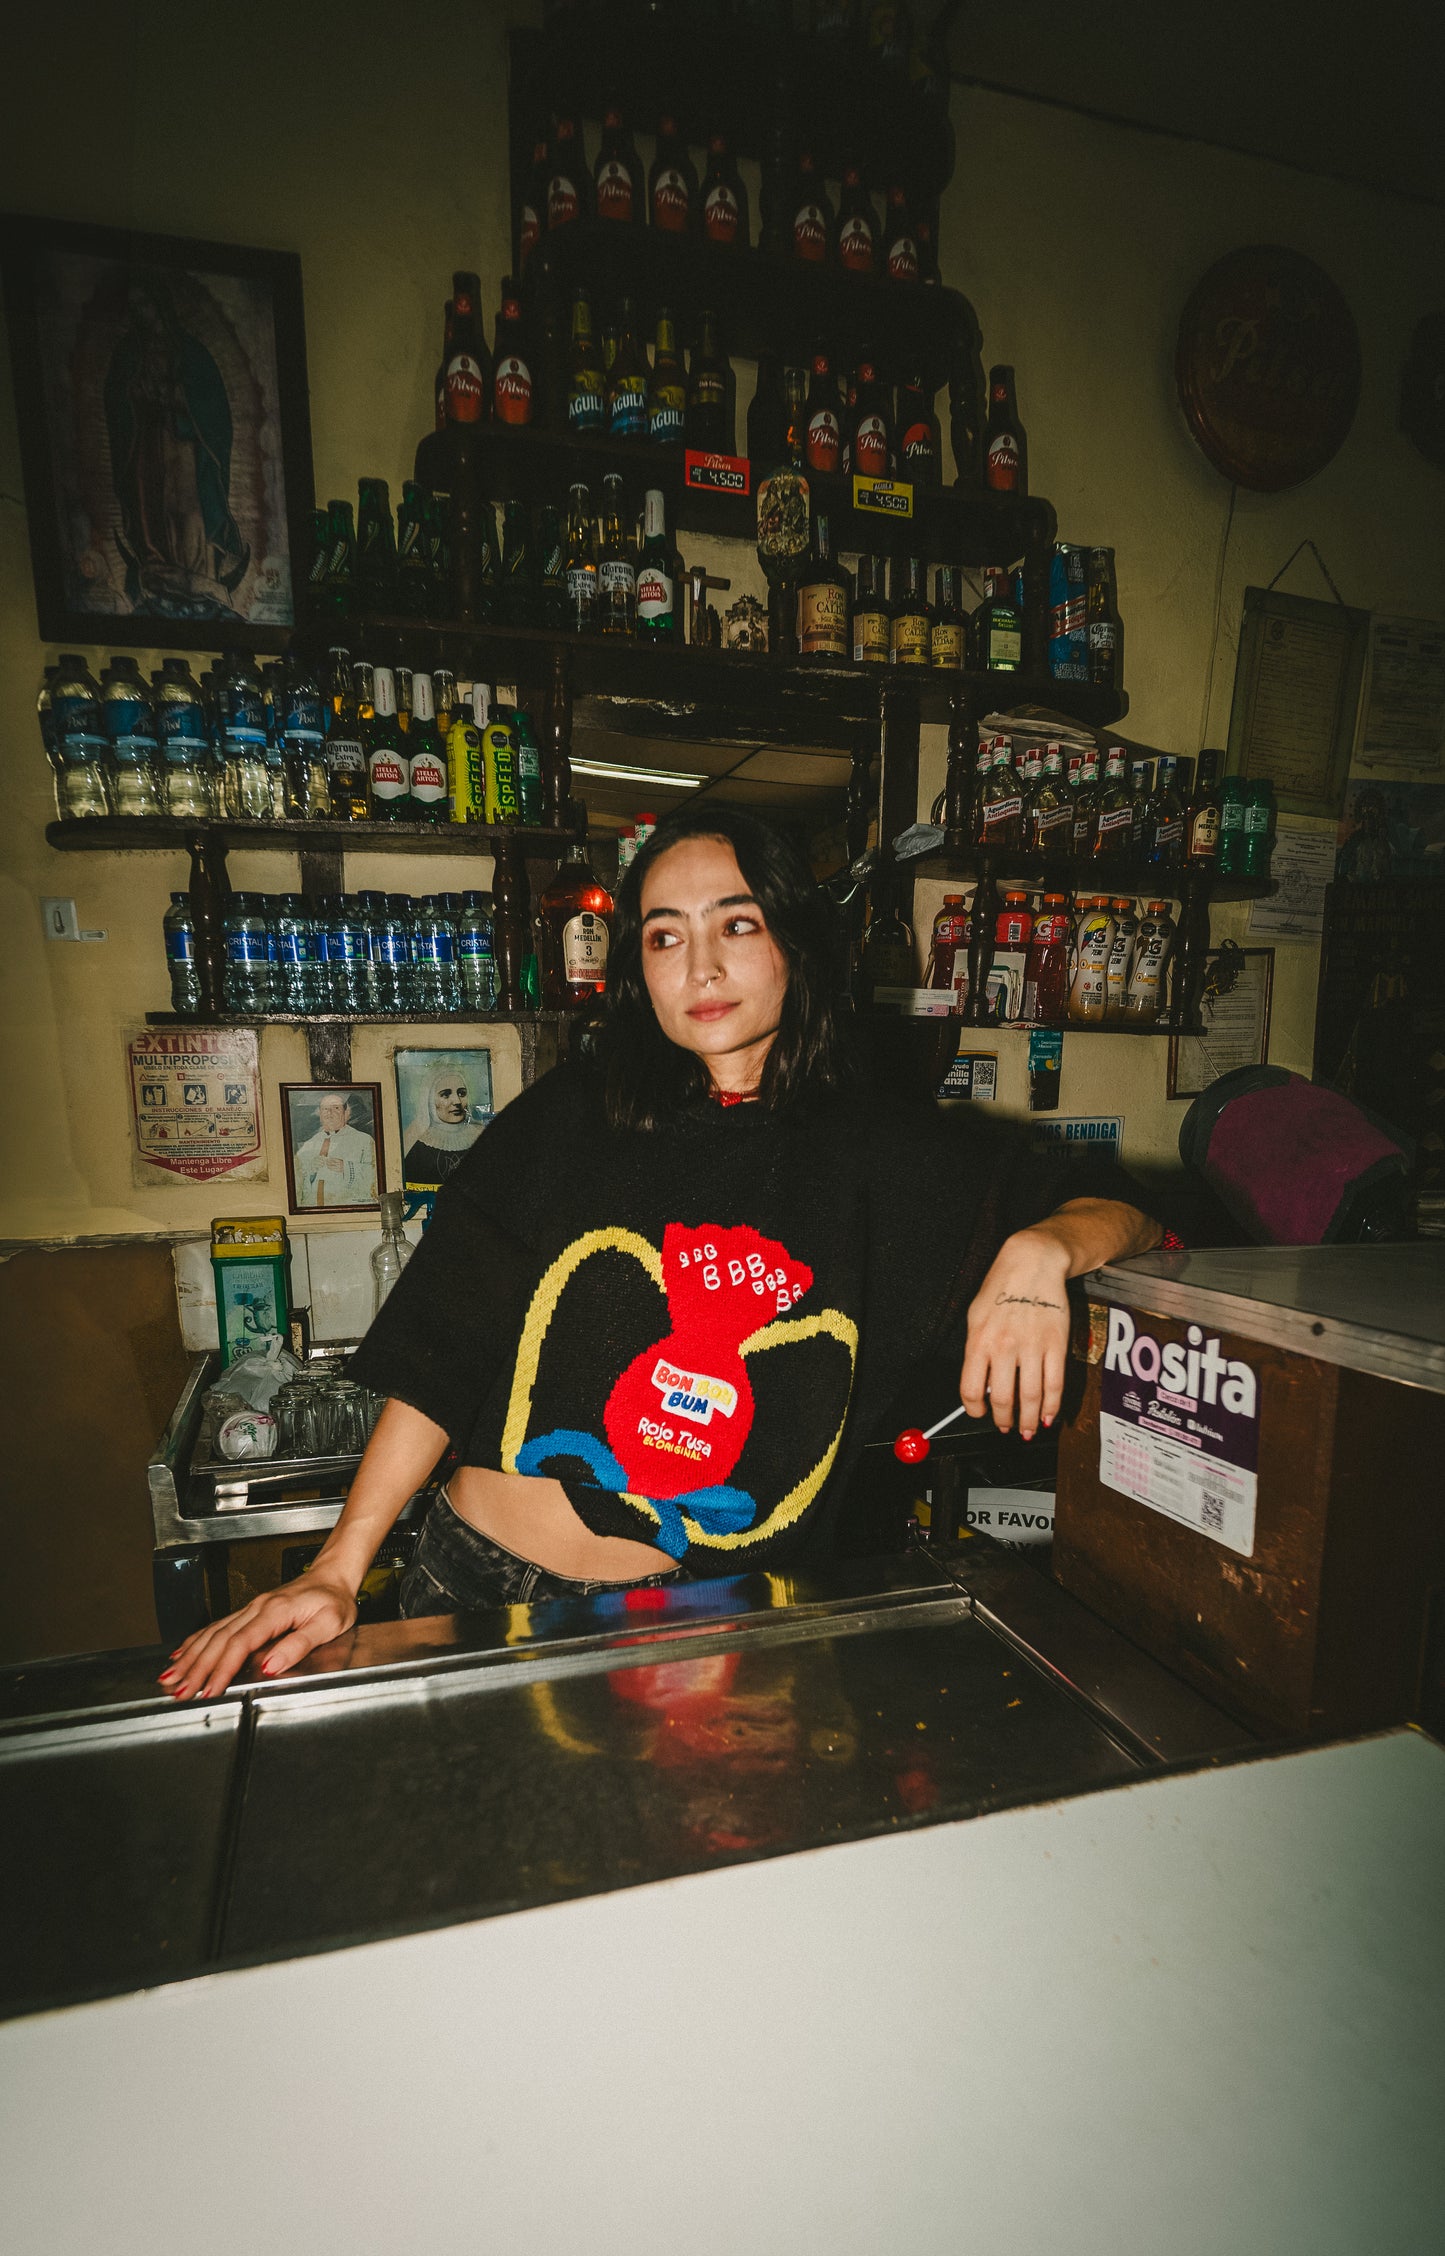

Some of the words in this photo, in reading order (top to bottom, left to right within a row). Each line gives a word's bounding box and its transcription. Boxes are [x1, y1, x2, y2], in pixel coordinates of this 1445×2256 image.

[611, 393, 645, 417] AGUILA
[327, 742, 362, 756] Corona
[335, 752, 355, 761] Extra
[375, 766, 398, 775] STELLA
[416, 770, 438, 778] STELLA
[375, 772, 399, 780] ARTOIS
[416, 776, 440, 784] ARTOIS
[497, 751, 516, 807] SPEED
[228, 937, 263, 947] CRISTAL
[461, 939, 491, 948] CRISTAL
[585, 945, 592, 956] 3
[1066, 1122, 1117, 1140] BENDIGA
[169, 1158, 210, 1166] Mantenga
[200, 1167, 225, 1175] Lugar
[1104, 1306, 1257, 1419] Rosita
[655, 1366, 694, 1392] BON
[696, 1379, 735, 1406] BON
[667, 1391, 709, 1414] BUM
[642, 1435, 655, 1447] EL
[655, 1439, 703, 1461] ORIGINAL
